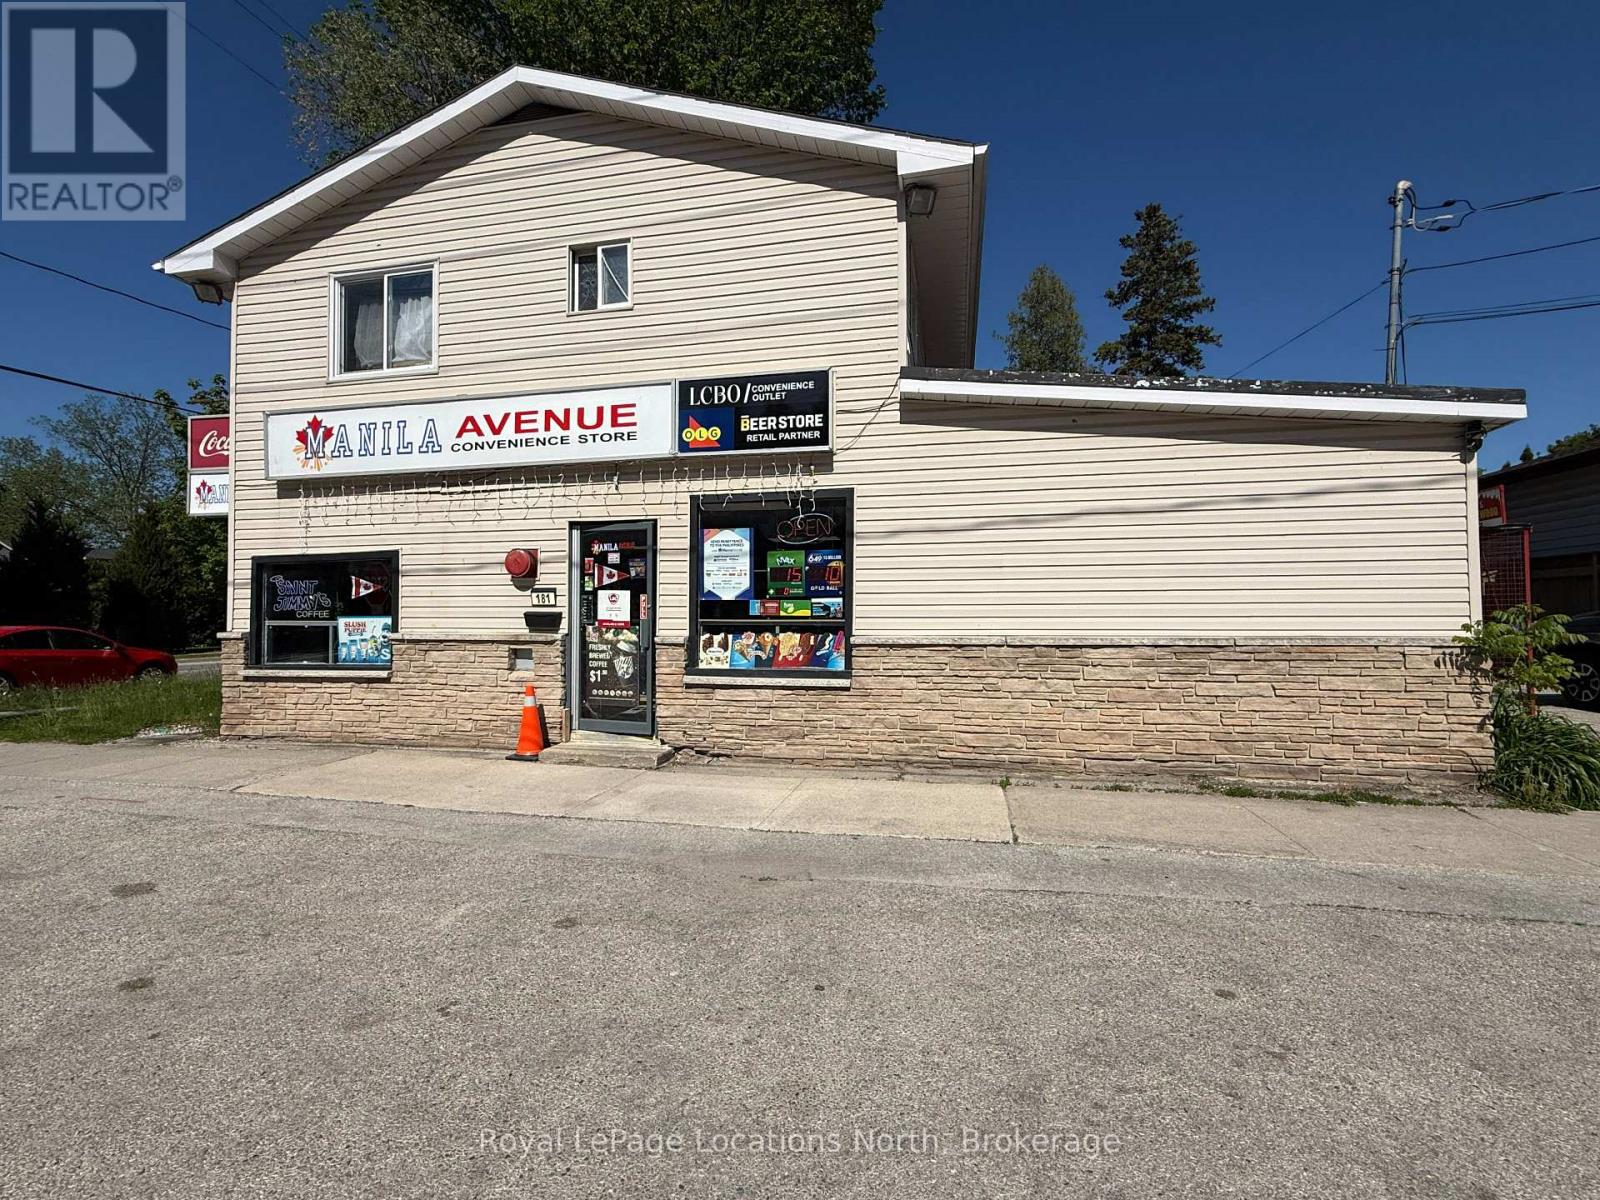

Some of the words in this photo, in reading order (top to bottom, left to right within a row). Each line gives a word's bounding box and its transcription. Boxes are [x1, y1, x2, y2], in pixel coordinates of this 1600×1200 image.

[752, 380, 815, 393] CONVENIENCE
[689, 383, 741, 406] LCBO
[752, 391, 787, 402] OUTLET
[455, 403, 637, 439] AVENUE
[740, 415, 777, 432] BEER
[778, 413, 824, 429] STORE
[304, 418, 442, 460] MANILA
[451, 435, 570, 453] CONVENIENCE
[578, 431, 637, 444] STORE
[746, 433, 777, 443] RETAIL
[778, 431, 821, 441] PARTNER
[778, 519, 832, 537] OPEN
[593, 542, 619, 553] MANILA
[776, 557, 796, 566] MAX
[274, 578, 319, 596] SAINT
[273, 592, 332, 612] JIMMY'S
[536, 594, 551, 603] 181
[296, 610, 330, 618] COFFEE
[588, 643, 611, 651] FRESHLY
[588, 660, 608, 668] COFFEE
